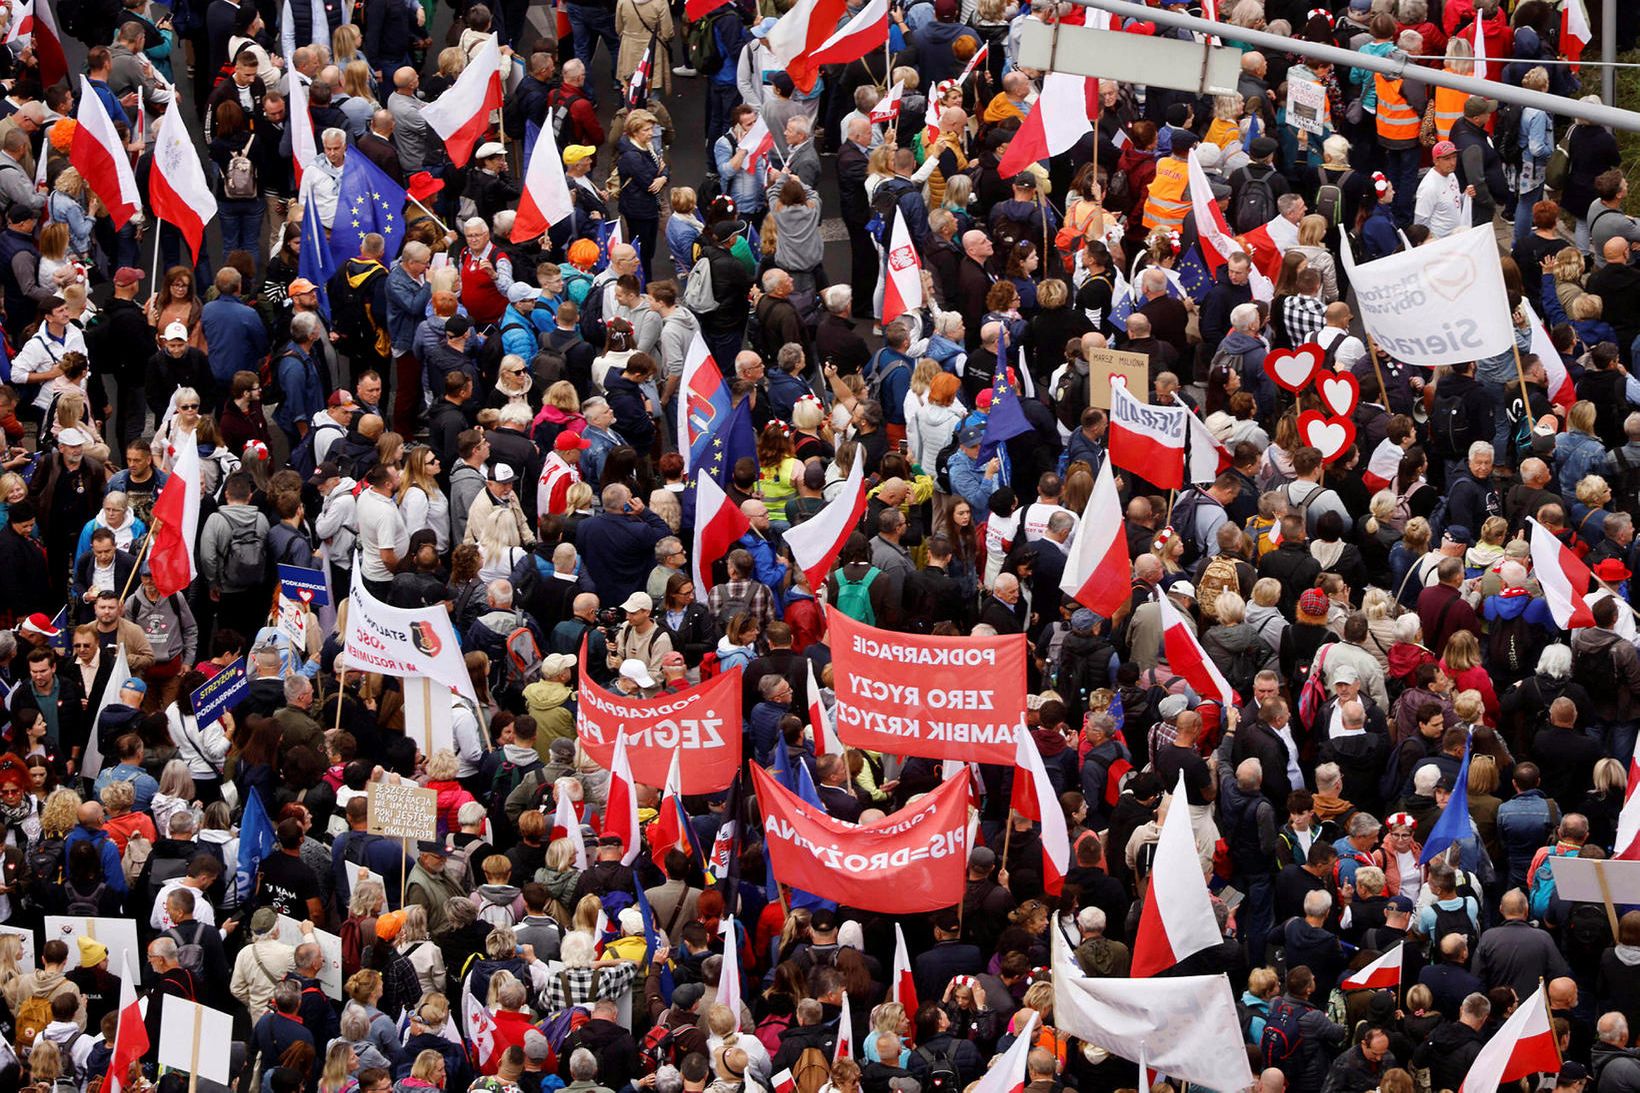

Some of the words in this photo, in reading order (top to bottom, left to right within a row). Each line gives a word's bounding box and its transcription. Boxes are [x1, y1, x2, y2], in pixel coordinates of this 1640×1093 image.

[195, 676, 248, 721] PODKARPACKIE
[376, 784, 413, 795] JESZCZE
[376, 793, 431, 806] DEMOKRACJA
[377, 815, 390, 824] NA
